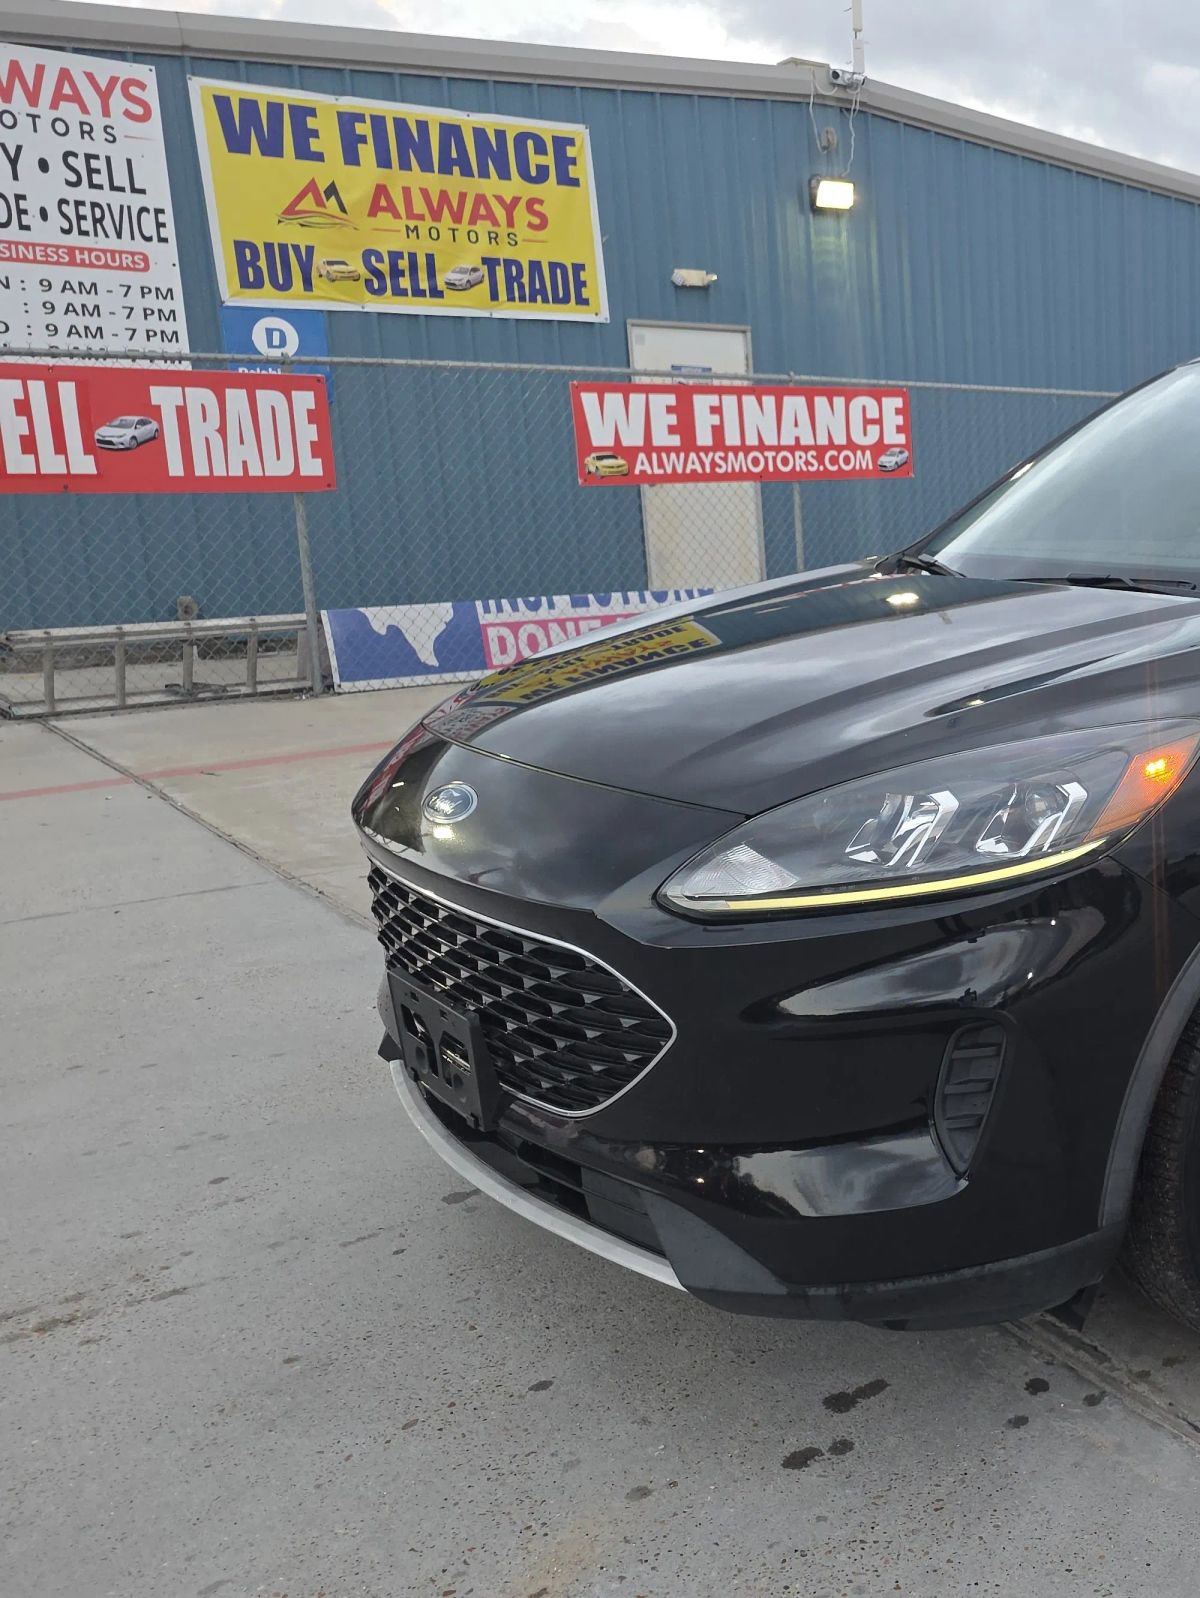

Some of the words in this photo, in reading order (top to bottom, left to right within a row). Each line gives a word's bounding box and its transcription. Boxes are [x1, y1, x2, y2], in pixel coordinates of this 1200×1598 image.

[0, 59, 153, 123] WAYS
[0, 109, 117, 144] OTORS
[212, 94, 325, 163] WE
[336, 111, 580, 188] FINANCE
[62, 150, 147, 195] SELL
[57, 198, 169, 243] SERVICE
[367, 183, 549, 231] ALWAYS
[405, 224, 518, 247] MOTORS
[75, 250, 145, 269] HOURS
[233, 239, 315, 293] BUY
[362, 248, 444, 299] SELL
[481, 256, 590, 307] TRADE
[39, 278, 52, 292] 9
[61, 280, 98, 295] AM
[119, 284, 131, 298] 7
[140, 286, 174, 301] PM
[42, 301, 55, 315] 9
[64, 302, 101, 318] AM
[122, 306, 134, 320] 7
[143, 307, 177, 322] PM
[45, 323, 58, 337] 9
[66, 324, 104, 340] AM
[125, 328, 137, 341] 7
[145, 329, 180, 344] PM
[265, 327, 287, 349] D
[150, 386, 323, 477] TRADE
[580, 392, 681, 447] WE
[692, 394, 906, 446] FINANCE
[634, 450, 873, 475] ALWAYSMOTORS.COM
